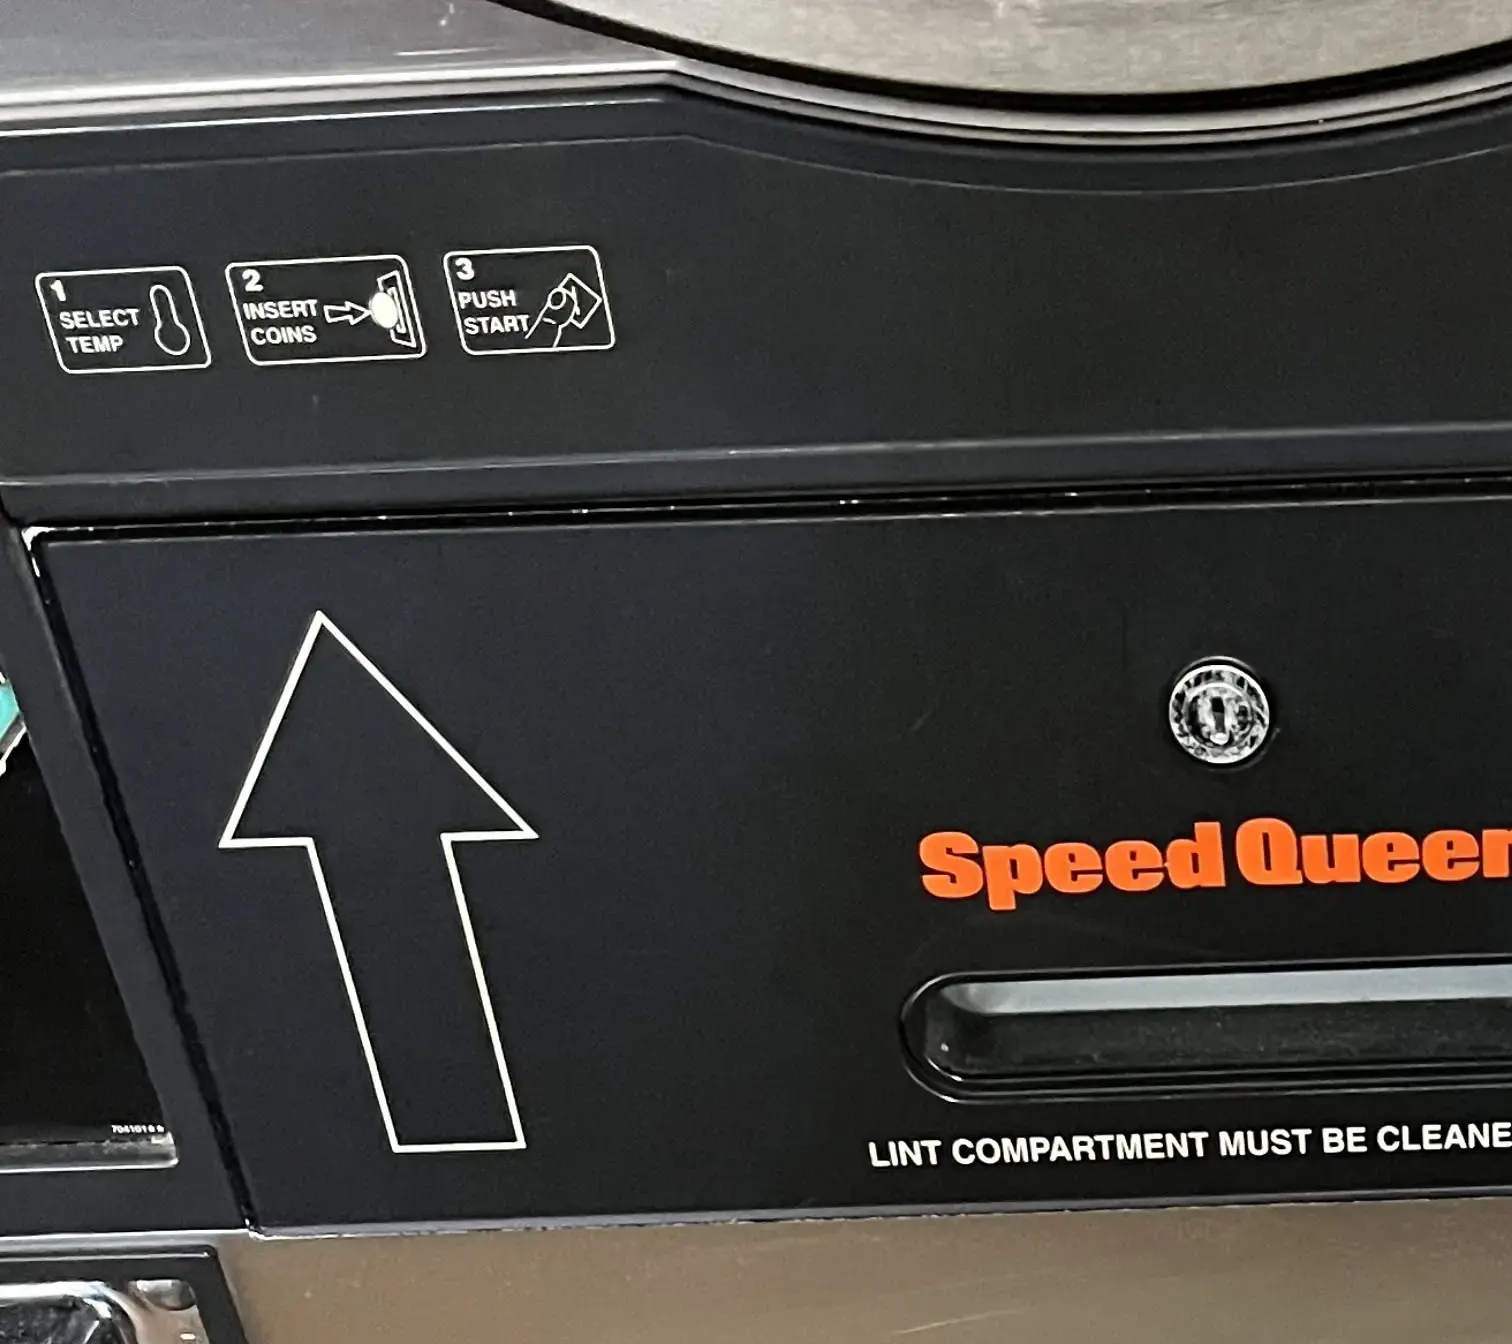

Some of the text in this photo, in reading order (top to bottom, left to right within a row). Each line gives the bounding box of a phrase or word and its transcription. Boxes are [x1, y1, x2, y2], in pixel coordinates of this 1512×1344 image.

[241, 268, 264, 292] 2
[454, 257, 475, 281] 3
[50, 279, 67, 302] 1
[457, 289, 517, 310] PUSH
[59, 308, 140, 330] SELECT
[242, 299, 318, 320] INSERT
[250, 324, 318, 346] COINS
[463, 313, 531, 335] START
[65, 335, 124, 354] TEMP
[919, 821, 1226, 911] Speed
[868, 1139, 942, 1167] LINT
[951, 1131, 1209, 1165] COMPARTMENT
[1218, 1128, 1313, 1157] MUST
[1322, 1126, 1368, 1154] BE
